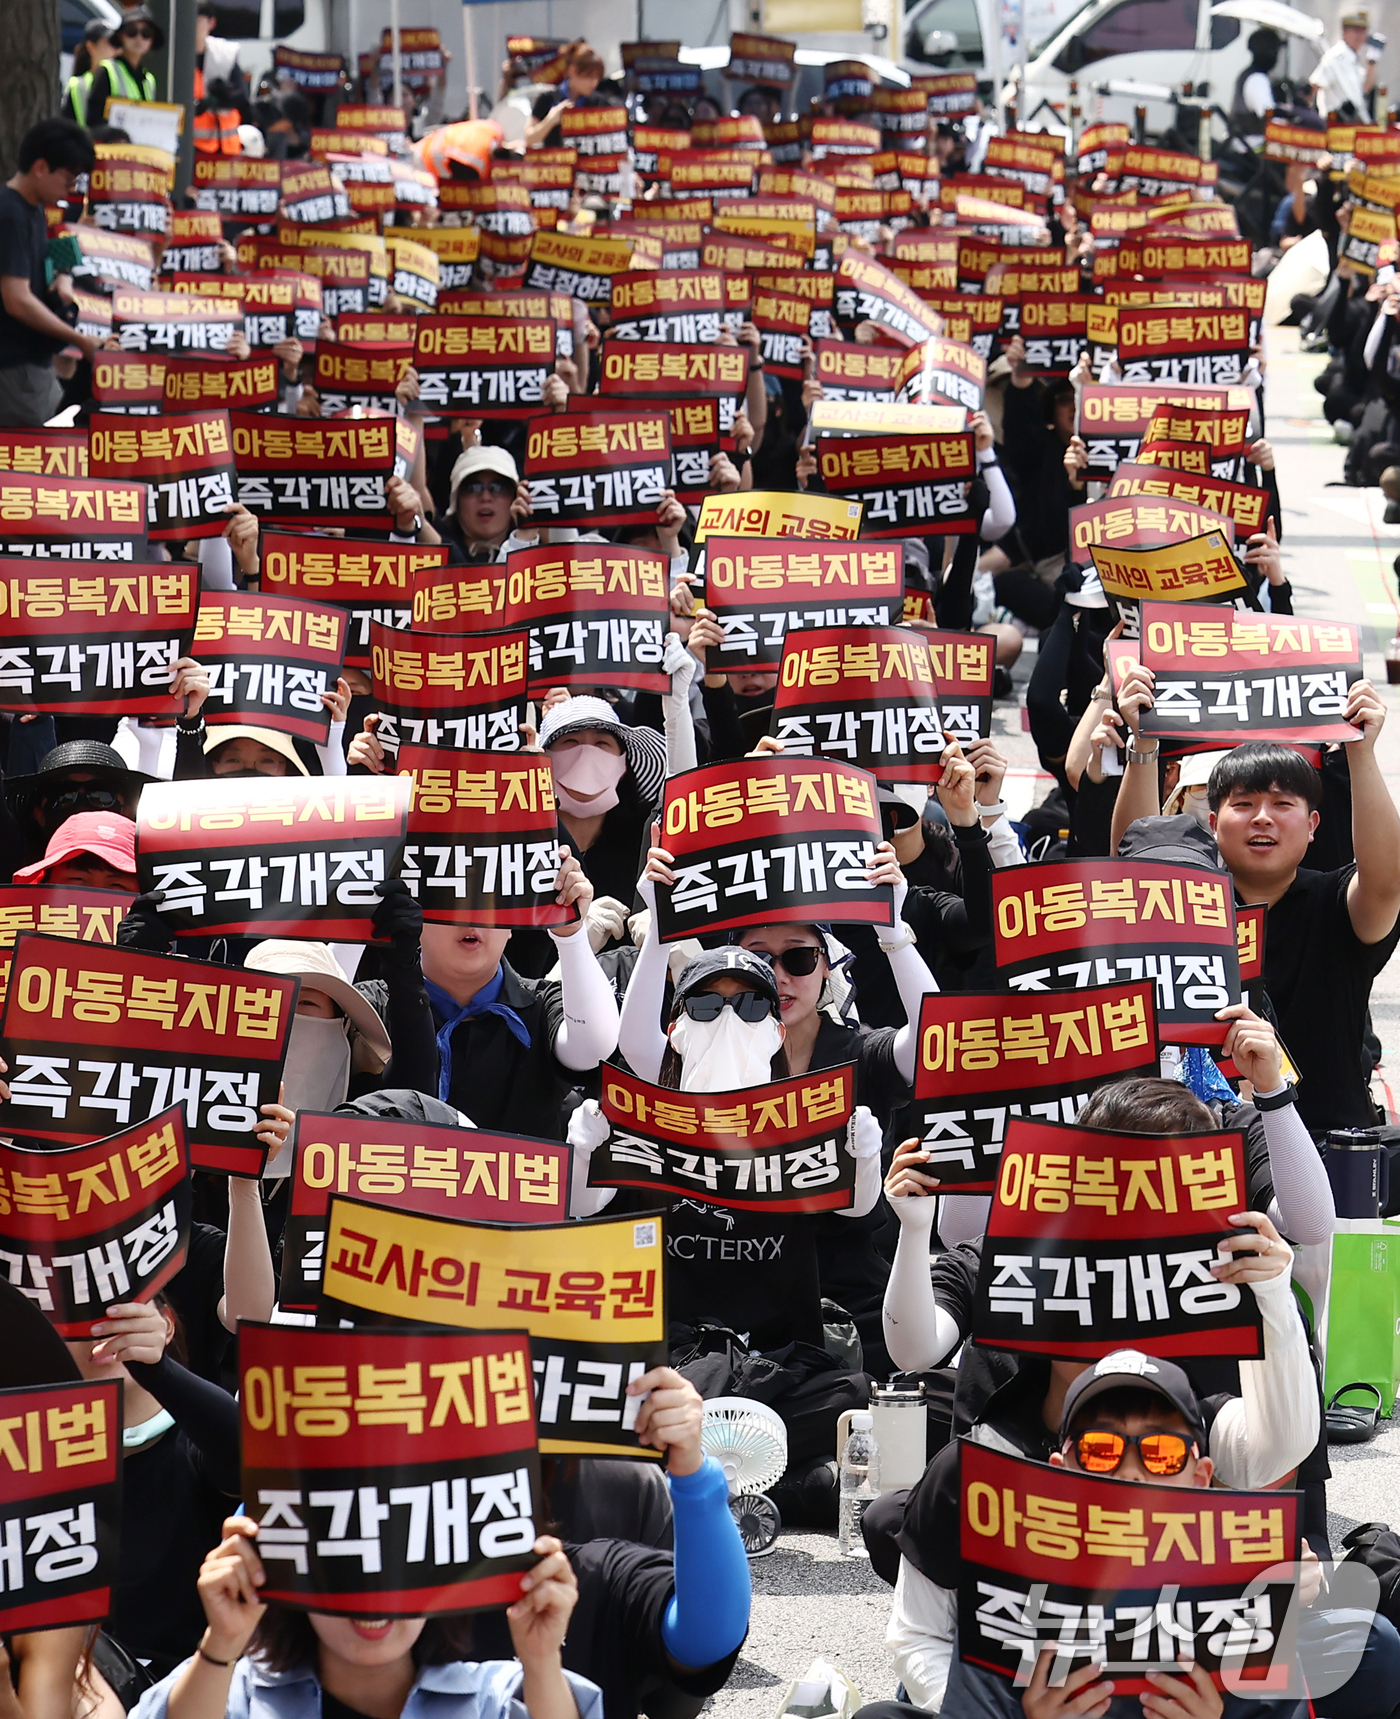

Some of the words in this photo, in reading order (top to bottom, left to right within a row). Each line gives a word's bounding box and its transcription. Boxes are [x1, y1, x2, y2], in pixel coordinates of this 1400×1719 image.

[282, 169, 331, 194] 복지법
[162, 245, 220, 271] 각개정
[896, 242, 958, 262] 아동복
[1143, 244, 1249, 269] 아동복지법
[116, 297, 240, 316] 아동복지법
[394, 272, 437, 305] 하라
[612, 276, 722, 307] 아동복지법
[338, 322, 416, 341] 아동복
[755, 297, 811, 326] 복지법
[1023, 303, 1087, 325] 아동복
[1121, 314, 1245, 346] 아동복지법
[118, 322, 235, 351] 즉각개정
[418, 325, 551, 355] 아동복지법
[761, 333, 803, 364] 개정
[1025, 338, 1088, 367] 즉각
[165, 364, 275, 399] 아동복지법
[318, 354, 413, 383] 아동복
[605, 353, 745, 382] 아동복지법
[820, 350, 904, 379] 아동복
[419, 369, 547, 405] 즉각개정
[908, 370, 980, 411] 각개정
[91, 419, 229, 463] 아동복지법
[232, 427, 389, 459] 아동복지법
[528, 419, 665, 459] 아동복지법
[1144, 417, 1244, 446] 동복지법
[822, 439, 970, 478] 아동복지법
[1, 487, 140, 521] 동복지법
[148, 472, 233, 522] 개정
[237, 476, 387, 510] 즉각개정
[528, 467, 666, 514] 즉각개정
[848, 482, 969, 522] 각개정
[701, 508, 771, 535] 교사의
[508, 558, 664, 600] 아동복지법
[711, 551, 896, 590] 아동복지법
[1097, 559, 1153, 591] 교사의
[1155, 555, 1237, 590] 교육권
[0, 574, 189, 618] 아동복지법
[413, 579, 505, 623] 아동복
[194, 606, 339, 651] 동복지법
[1147, 621, 1353, 657] 아동복지법
[0, 639, 180, 694] 즉각개정
[372, 641, 524, 691] 아동복지법
[782, 642, 935, 688] 아동복지법
[204, 664, 327, 712] 각개정
[1153, 671, 1349, 723] 즉각개정
[376, 706, 520, 760] 즉각개정
[776, 706, 947, 758] 즉각개정
[666, 772, 875, 836] 아동복지법
[152, 849, 385, 916] 즉각개정
[670, 840, 878, 913] 즉각개정
[0, 904, 126, 947] 동복지
[998, 878, 1228, 939] 아동복지법
[17, 966, 283, 1040] 아동복지법
[923, 994, 1149, 1072] 아동복지법
[9, 1054, 261, 1133] 즉각개정
[607, 1077, 845, 1137] 아동복지법
[921, 1093, 1089, 1170] 즉각
[0, 1122, 180, 1220] 복지법
[302, 1143, 559, 1205] 아동복지법
[609, 1138, 840, 1192] 즉각개정
[1000, 1147, 1239, 1216] 아동복지법
[0, 1200, 179, 1311] 각개정
[666, 1234, 785, 1261] RC'TERYX
[330, 1227, 481, 1307] 교사의
[497, 1269, 656, 1320] 교육권
[988, 1248, 1242, 1326] 즉각개정
[244, 1350, 530, 1437] 아동복지법
[256, 1467, 535, 1575] 즉각개정
[966, 1481, 1284, 1566] 아동복지법
[975, 1581, 1275, 1672] 즉각개정
